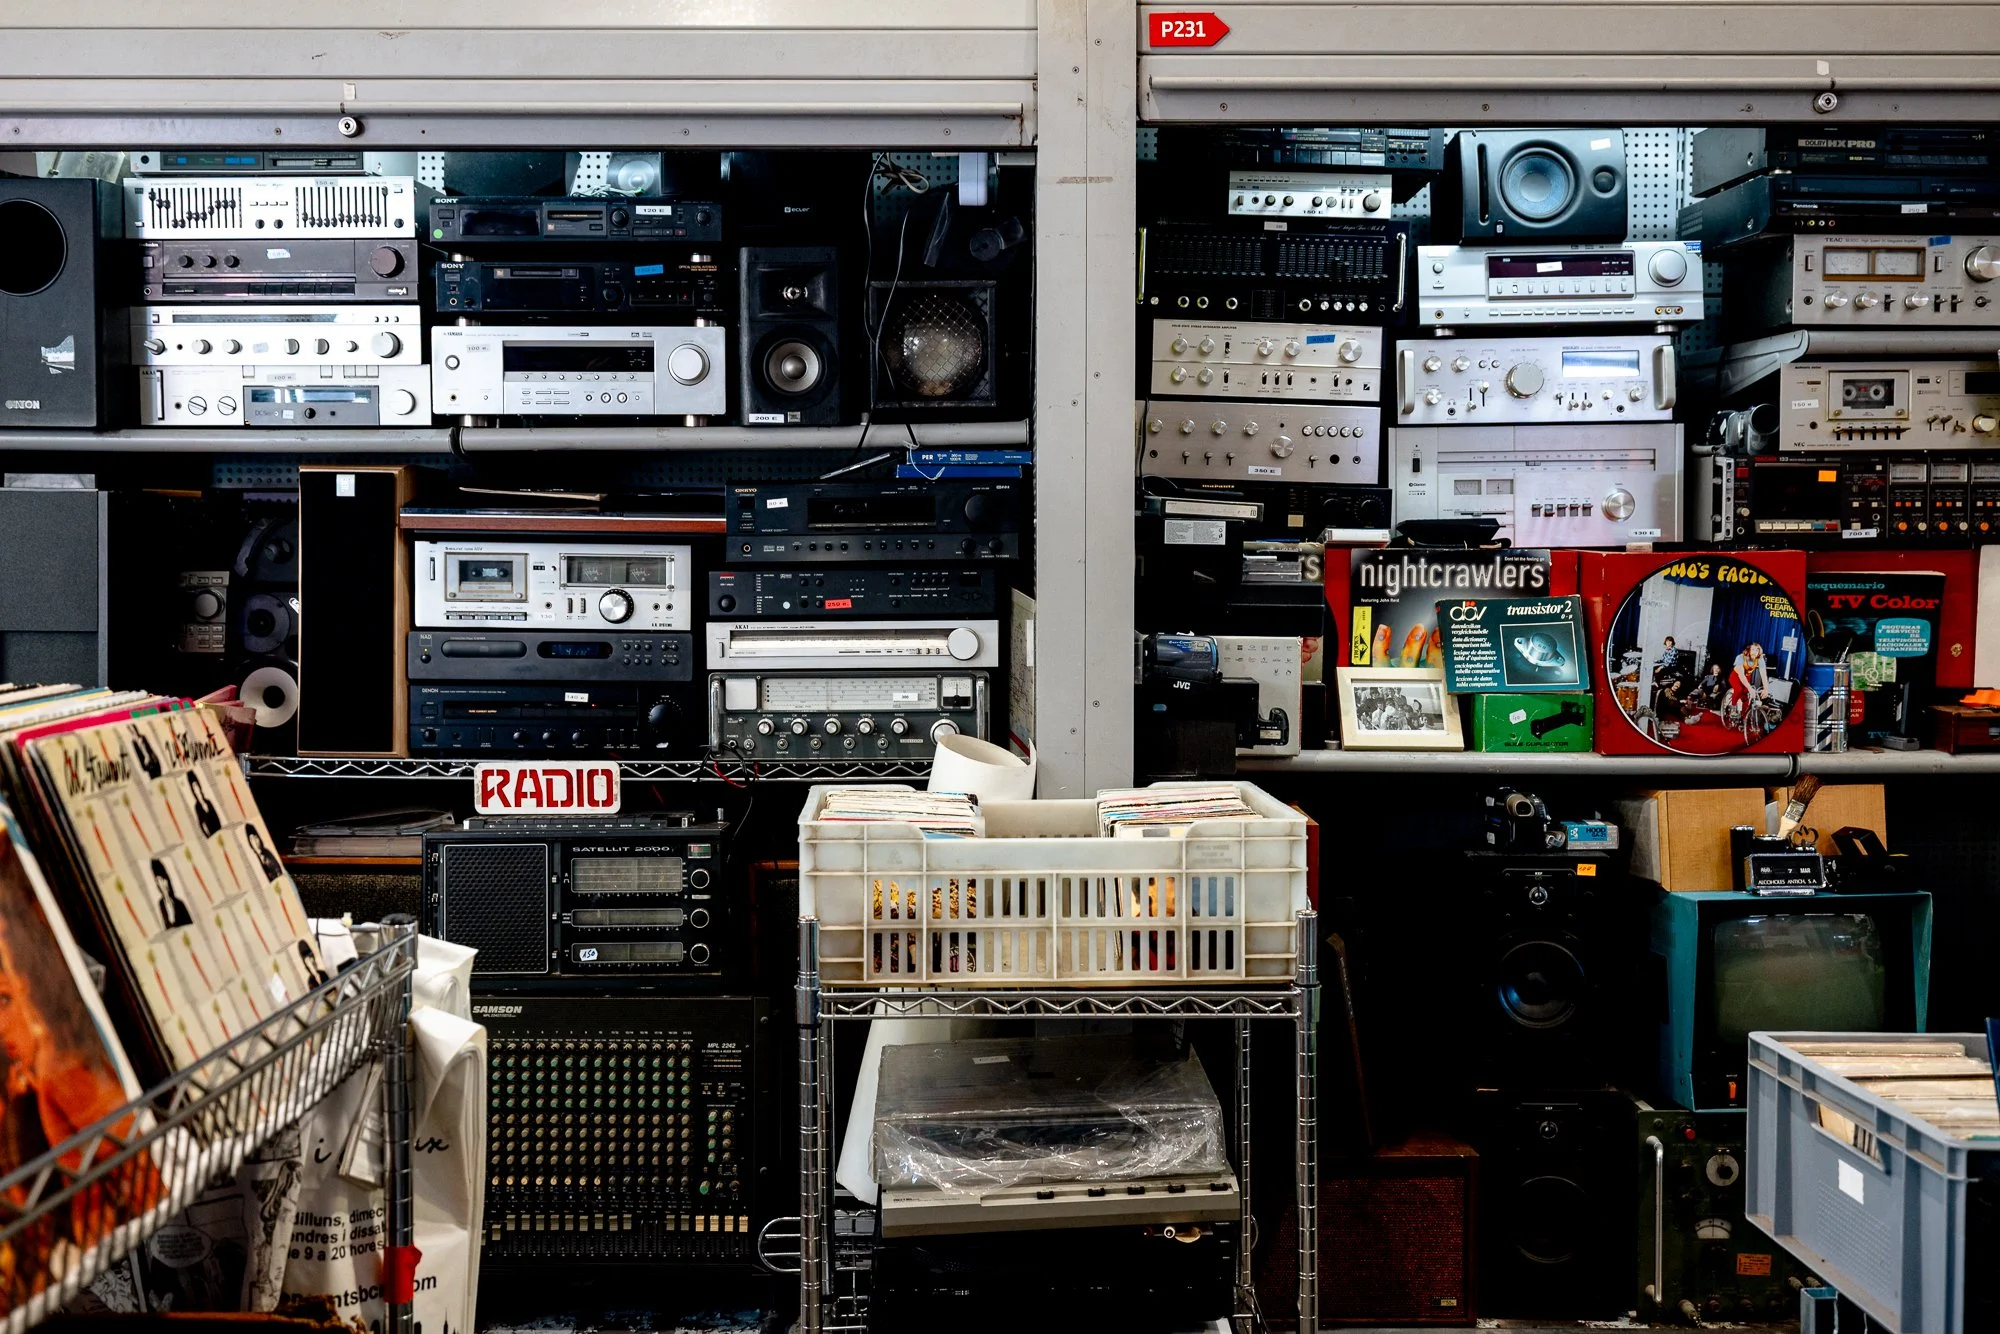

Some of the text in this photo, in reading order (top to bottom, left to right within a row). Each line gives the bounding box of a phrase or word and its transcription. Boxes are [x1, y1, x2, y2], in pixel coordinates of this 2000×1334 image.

[1161, 21, 1206, 38] P231
[1827, 140, 1846, 148] HX
[1848, 140, 1876, 148] PRO
[1360, 555, 1545, 596] nightcrawlers
[1807, 581, 1886, 591] esquemario
[1507, 600, 1572, 616] transistor 2
[1828, 595, 1940, 609] TV Color
[1770, 610, 1798, 620] REVIVAL
[1173, 681, 1191, 690] JVC
[480, 768, 614, 808] RADIO
[582, 949, 596, 959] 150
[472, 1005, 523, 1014] SAMSON
[342, 1229, 347, 1242] i
[303, 1246, 314, 1260] 9
[317, 1251, 326, 1261] a
[330, 1245, 346, 1260] 20
[350, 1239, 384, 1257] hores
